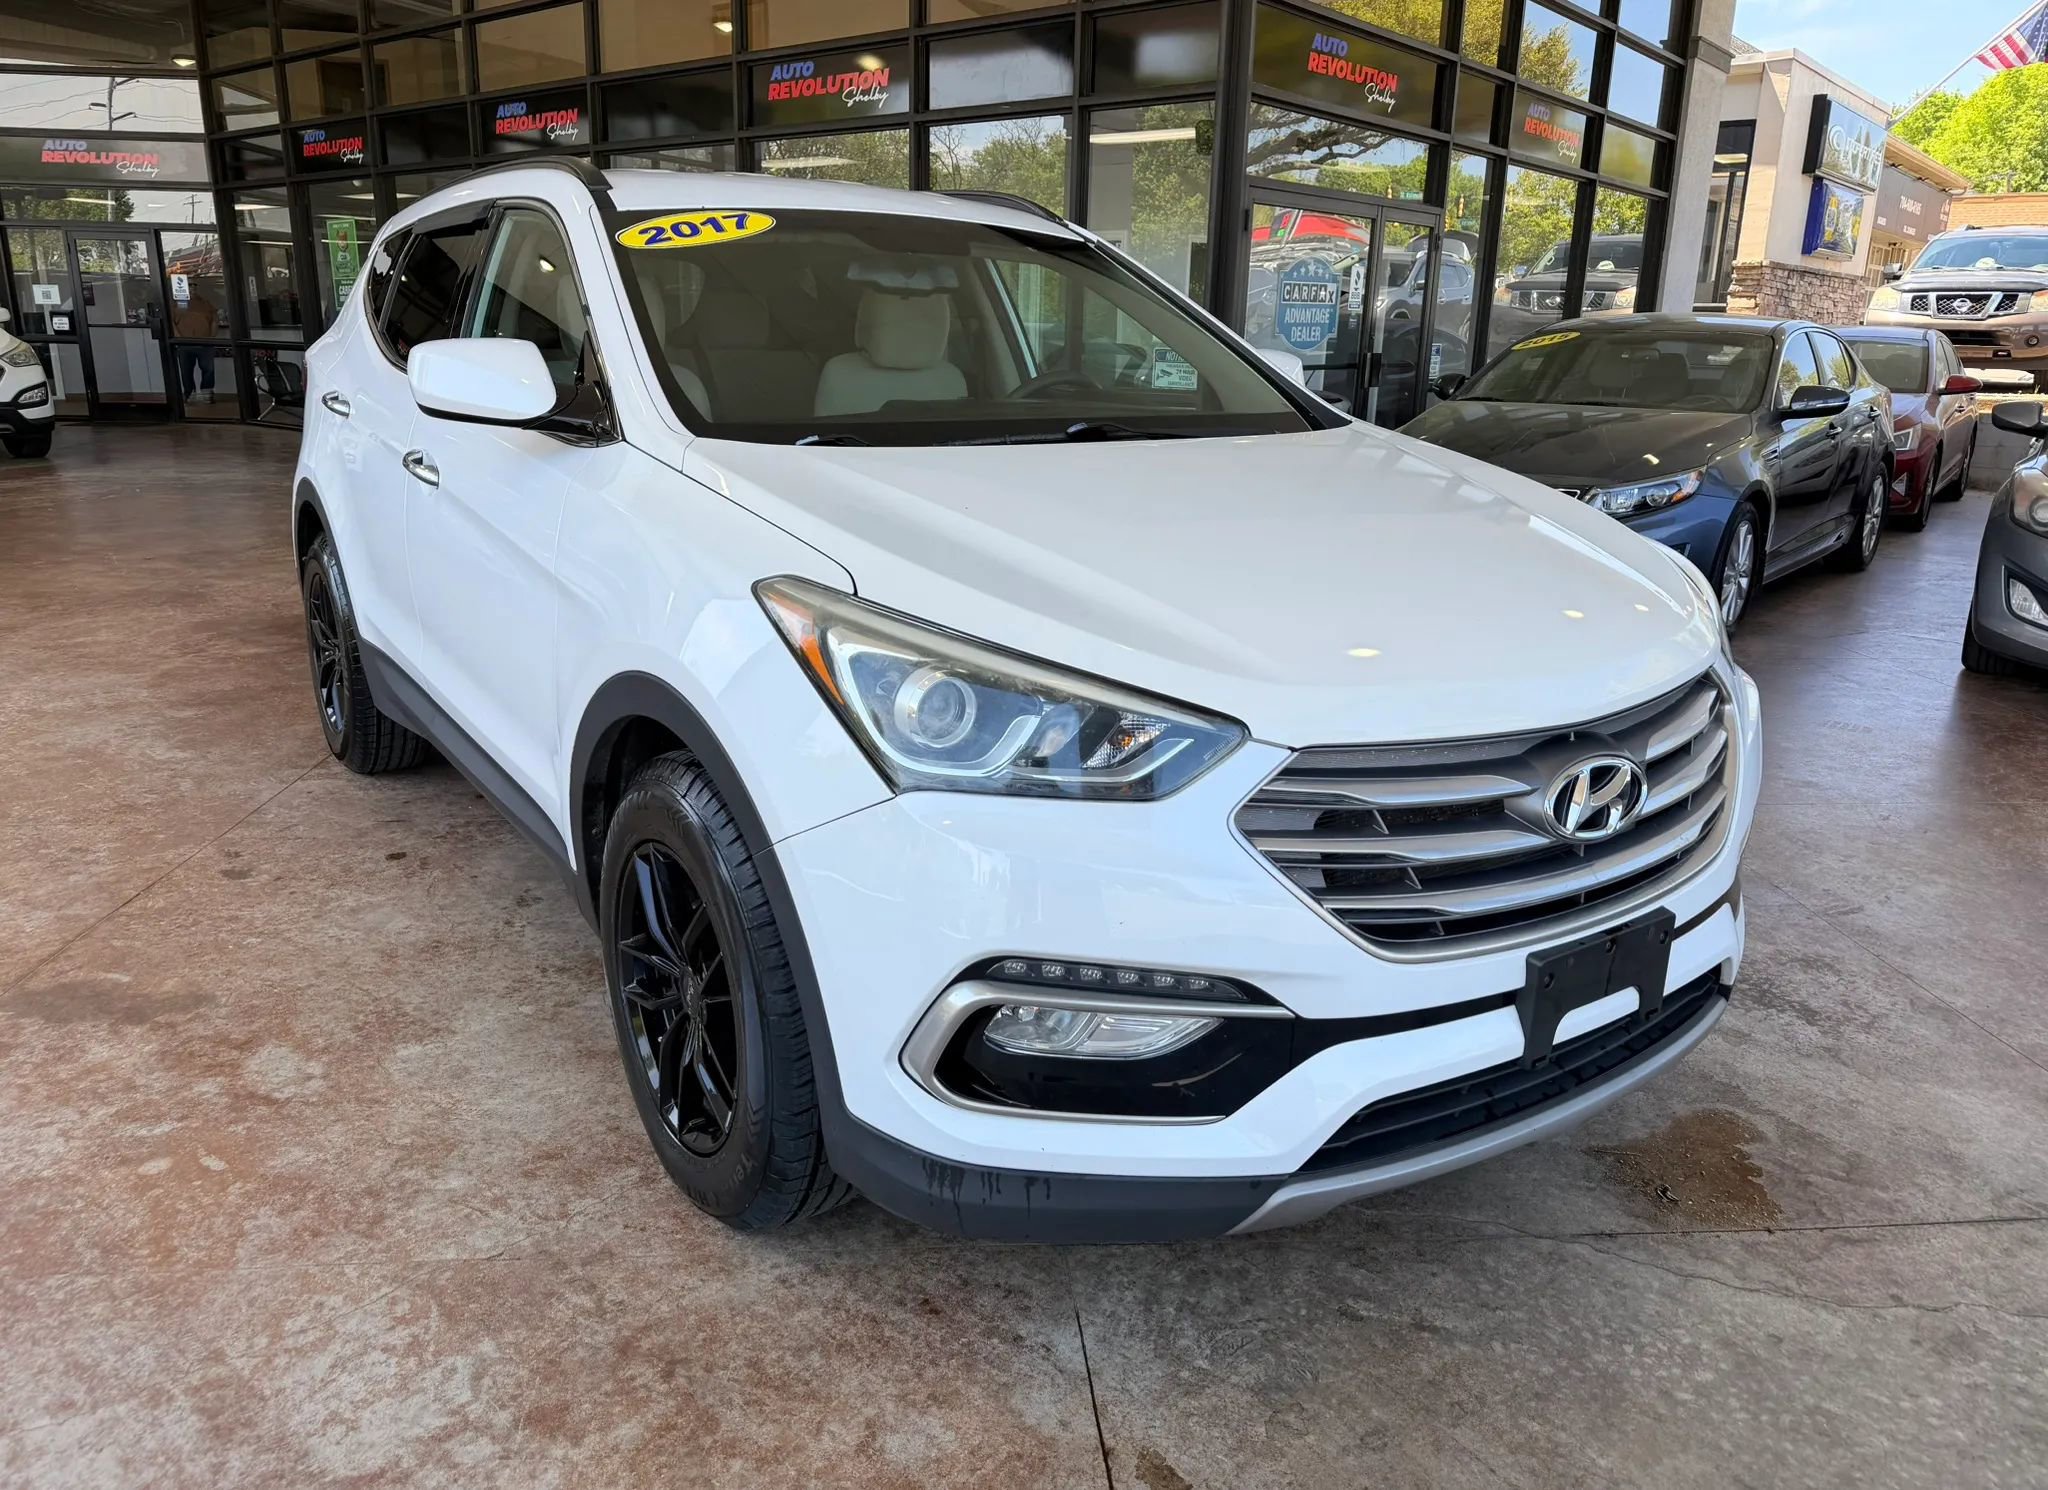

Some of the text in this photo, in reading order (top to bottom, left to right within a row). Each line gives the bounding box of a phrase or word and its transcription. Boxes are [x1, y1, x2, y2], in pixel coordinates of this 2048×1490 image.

[1312, 33, 1348, 57] AUTO
[771, 61, 815, 80] AUTO
[1308, 51, 1398, 92] REVOLUTION
[768, 68, 890, 101] REVOLUTION
[842, 82, 889, 109] Shelby
[1365, 83, 1396, 113] Shelby
[496, 101, 527, 118] AUTO
[1527, 103, 1551, 121] AUTO
[495, 108, 578, 135] REVOLUTION
[546, 120, 579, 141] Shelby
[303, 130, 326, 143] AUTO
[1524, 117, 1580, 148] REVOLUTION
[43, 140, 87, 150] AUTO
[303, 137, 363, 157] REVOLUTION
[41, 150, 159, 165] REVOLUTION
[116, 160, 161, 178] Shelby
[638, 213, 750, 245] 2017
[1283, 283, 1335, 304] CARFAX
[1284, 307, 1330, 323] ADVANTAGE
[1291, 326, 1321, 341] DEALER
